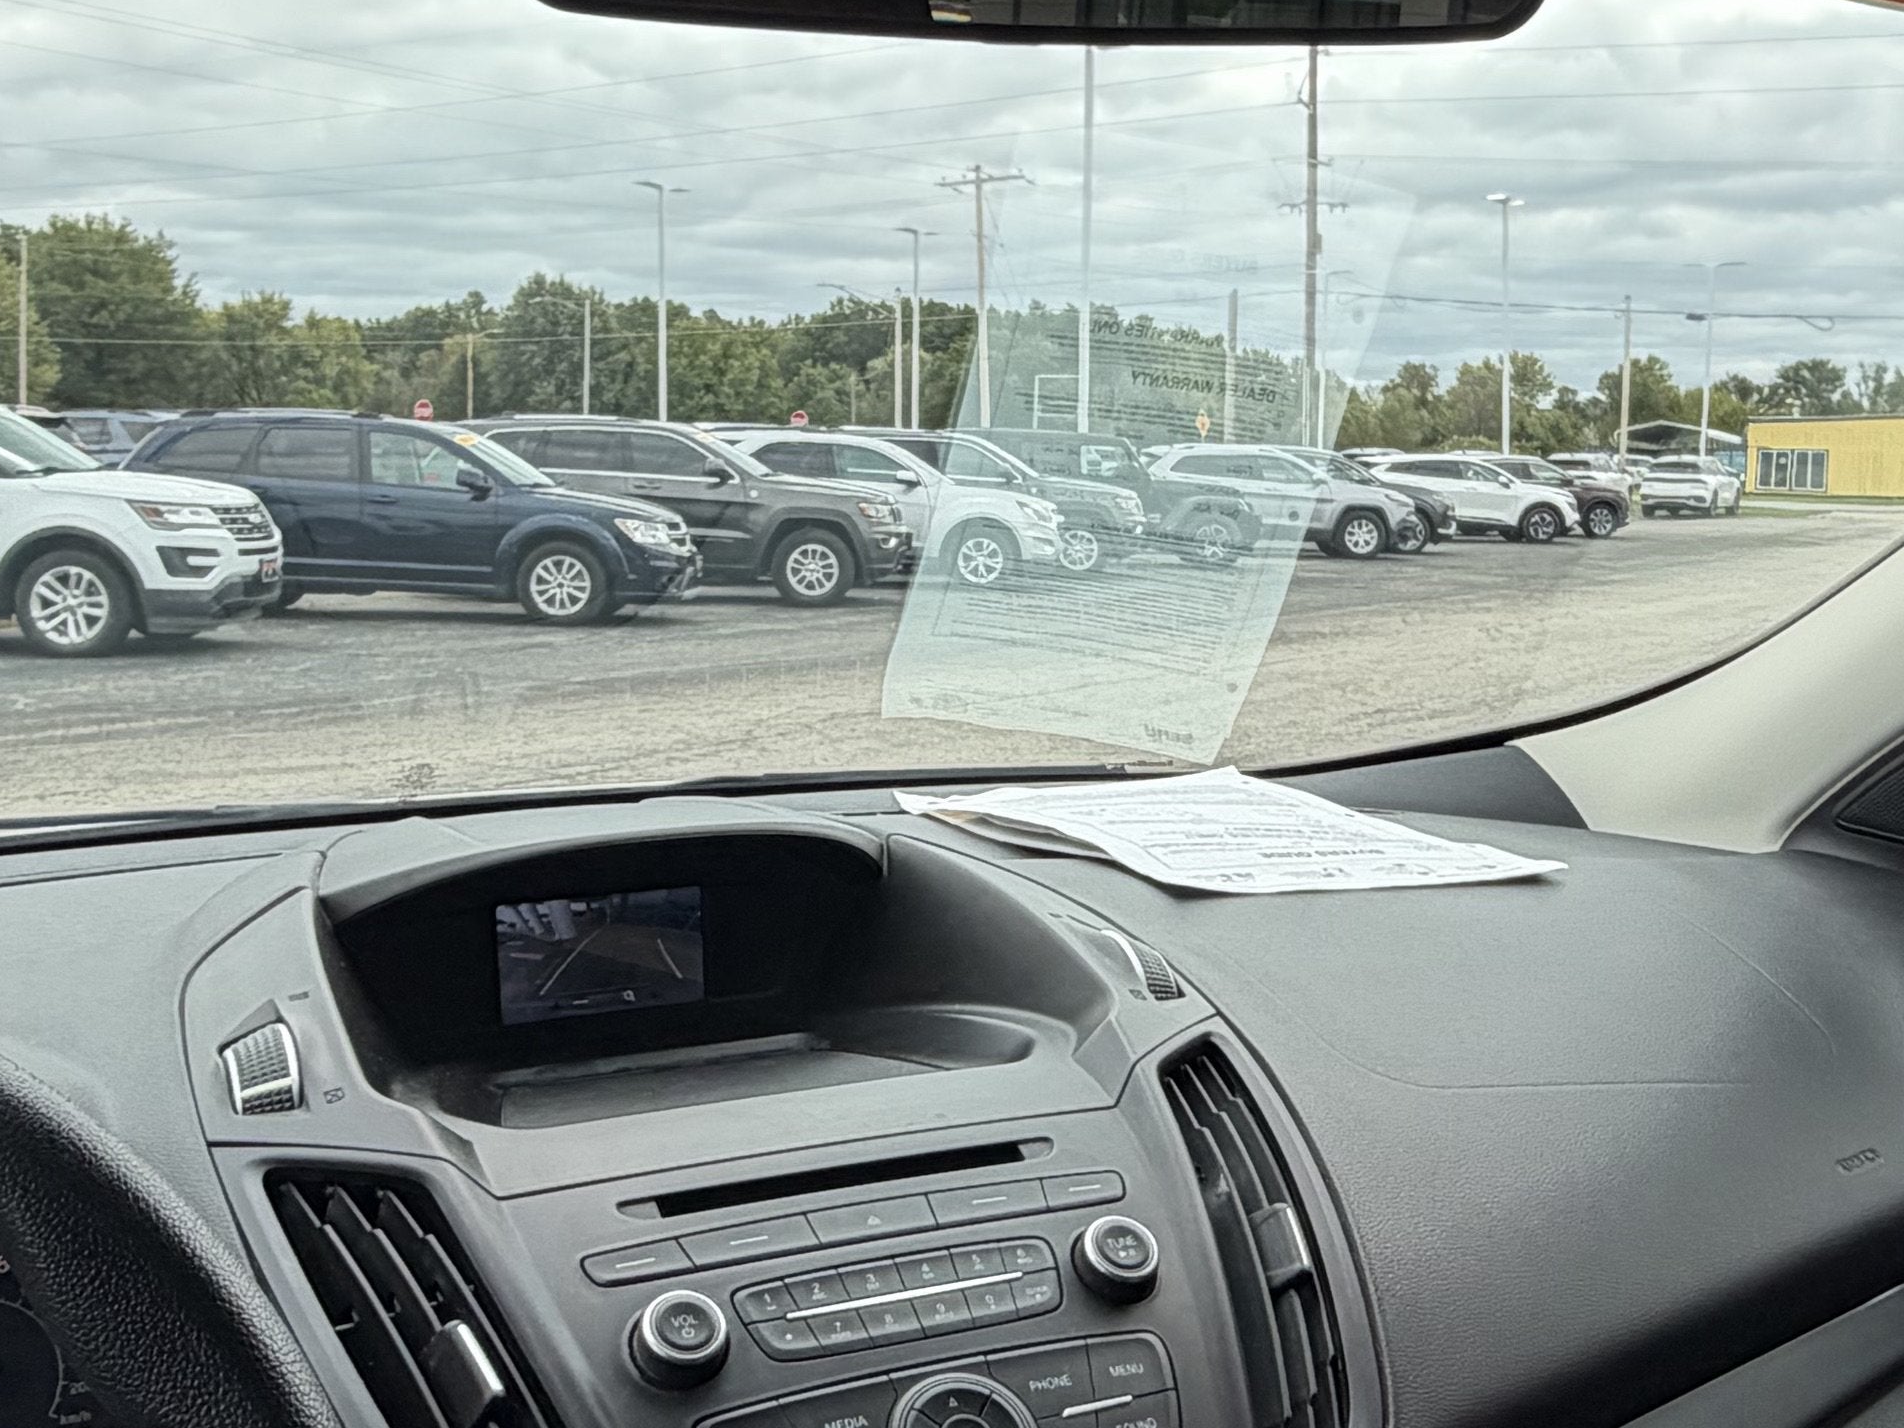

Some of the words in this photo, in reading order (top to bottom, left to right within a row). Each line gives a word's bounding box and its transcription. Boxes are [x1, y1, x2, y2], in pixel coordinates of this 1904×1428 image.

[670, 1313, 699, 1328] VOL
[1108, 1361, 1144, 1378] MENU
[1028, 1373, 1073, 1392] PHONE
